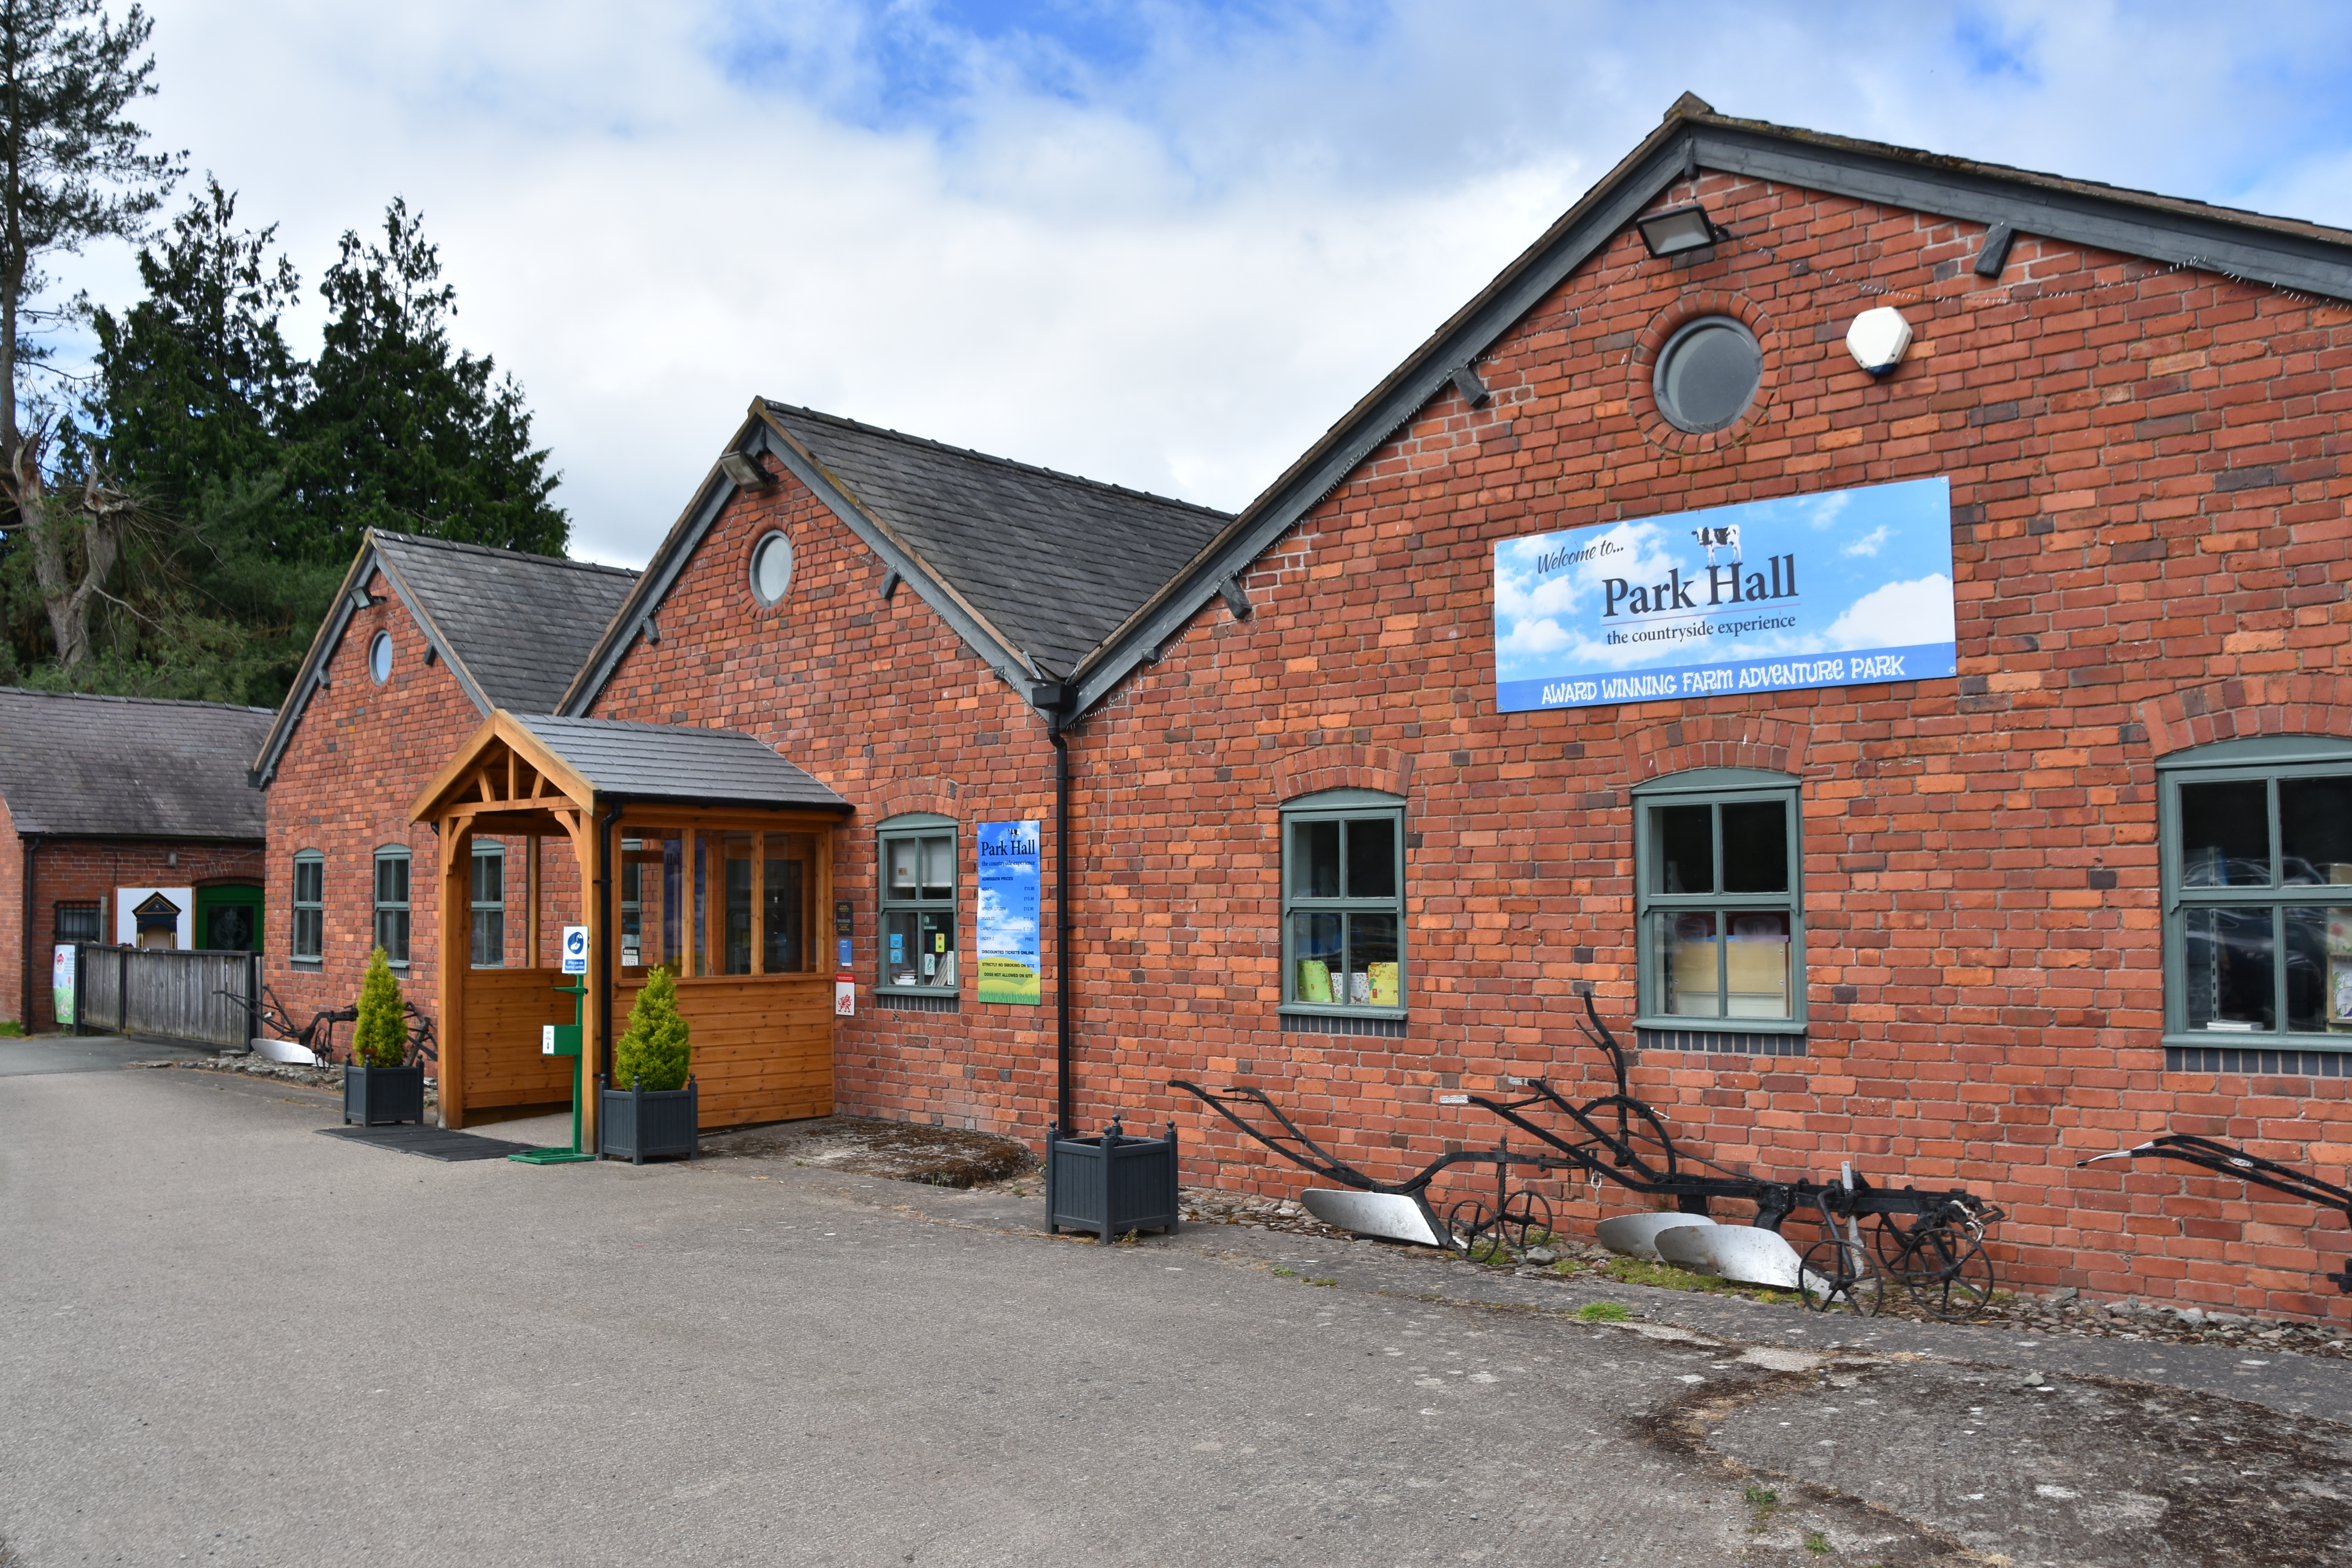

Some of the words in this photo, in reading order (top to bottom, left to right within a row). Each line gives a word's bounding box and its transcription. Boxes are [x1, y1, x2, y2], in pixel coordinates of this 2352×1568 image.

[1538, 546, 1596, 574] Welcome
[1600, 540, 1624, 556] to...
[1602, 568, 1697, 617] Park
[1705, 553, 1799, 606] Hall
[1606, 630, 1628, 645] the
[1632, 621, 1714, 642] countryside
[1718, 616, 1796, 637] experience
[1541, 682, 1597, 704] AWARD
[1601, 674, 1677, 699] WINNING
[1851, 655, 1906, 679] PARK
[981, 840, 1007, 856] Park
[1011, 839, 1035, 855] Hall
